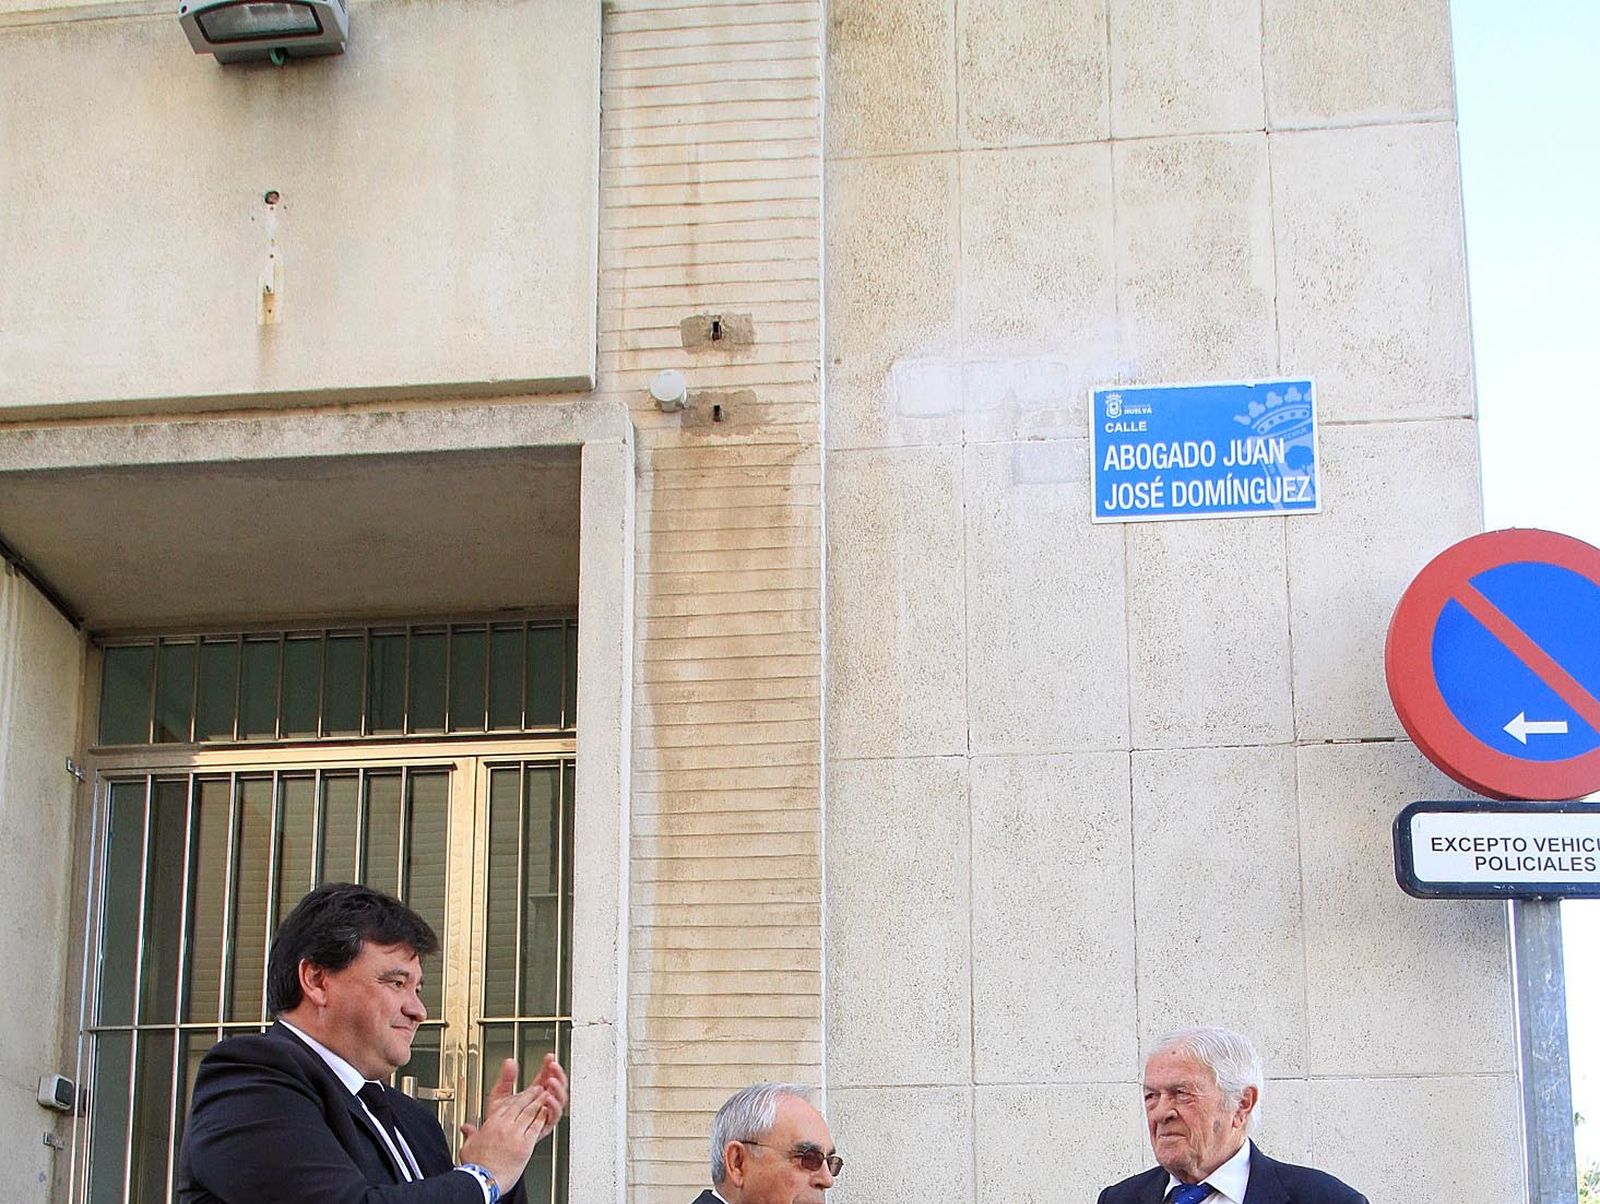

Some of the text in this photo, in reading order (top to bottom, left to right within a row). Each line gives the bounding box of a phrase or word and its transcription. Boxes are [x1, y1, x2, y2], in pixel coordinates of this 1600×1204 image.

[1124, 407, 1152, 415] HUELVA
[1104, 421, 1148, 433] CALLE
[1103, 437, 1286, 472] ABOGADO JUAN
[1104, 472, 1312, 511] JOSÉ DOMÍNGUEZ
[1431, 837, 1528, 853] EXCEPTO
[1475, 856, 1597, 872] POLICIALES
